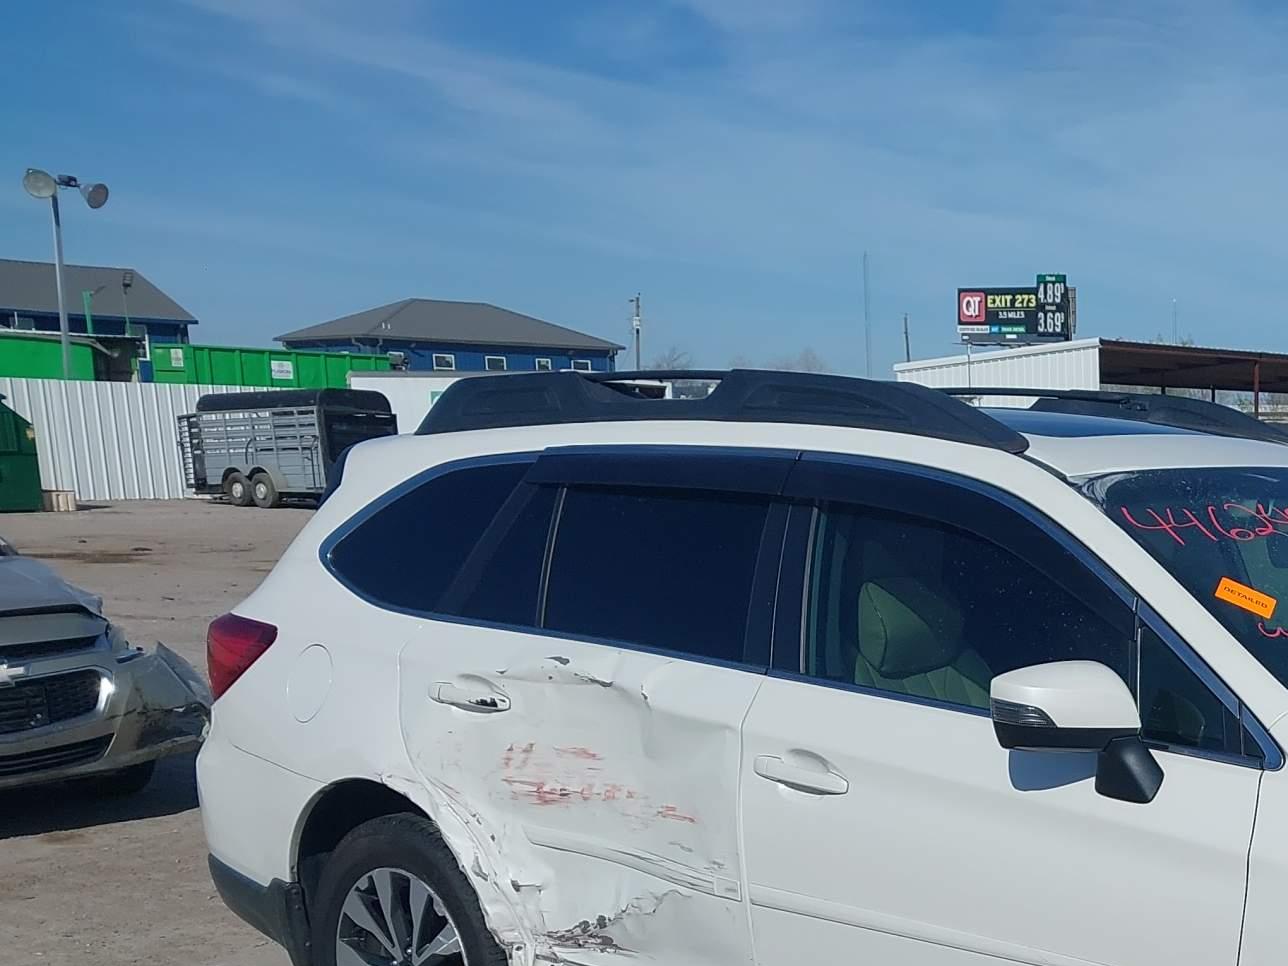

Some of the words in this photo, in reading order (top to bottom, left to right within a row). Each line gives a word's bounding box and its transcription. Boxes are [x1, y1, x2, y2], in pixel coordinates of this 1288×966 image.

[962, 296, 982, 317] QT
[987, 296, 1012, 308] EXIT
[1014, 295, 1036, 308] 273
[1223, 586, 1268, 609] DETAILED
